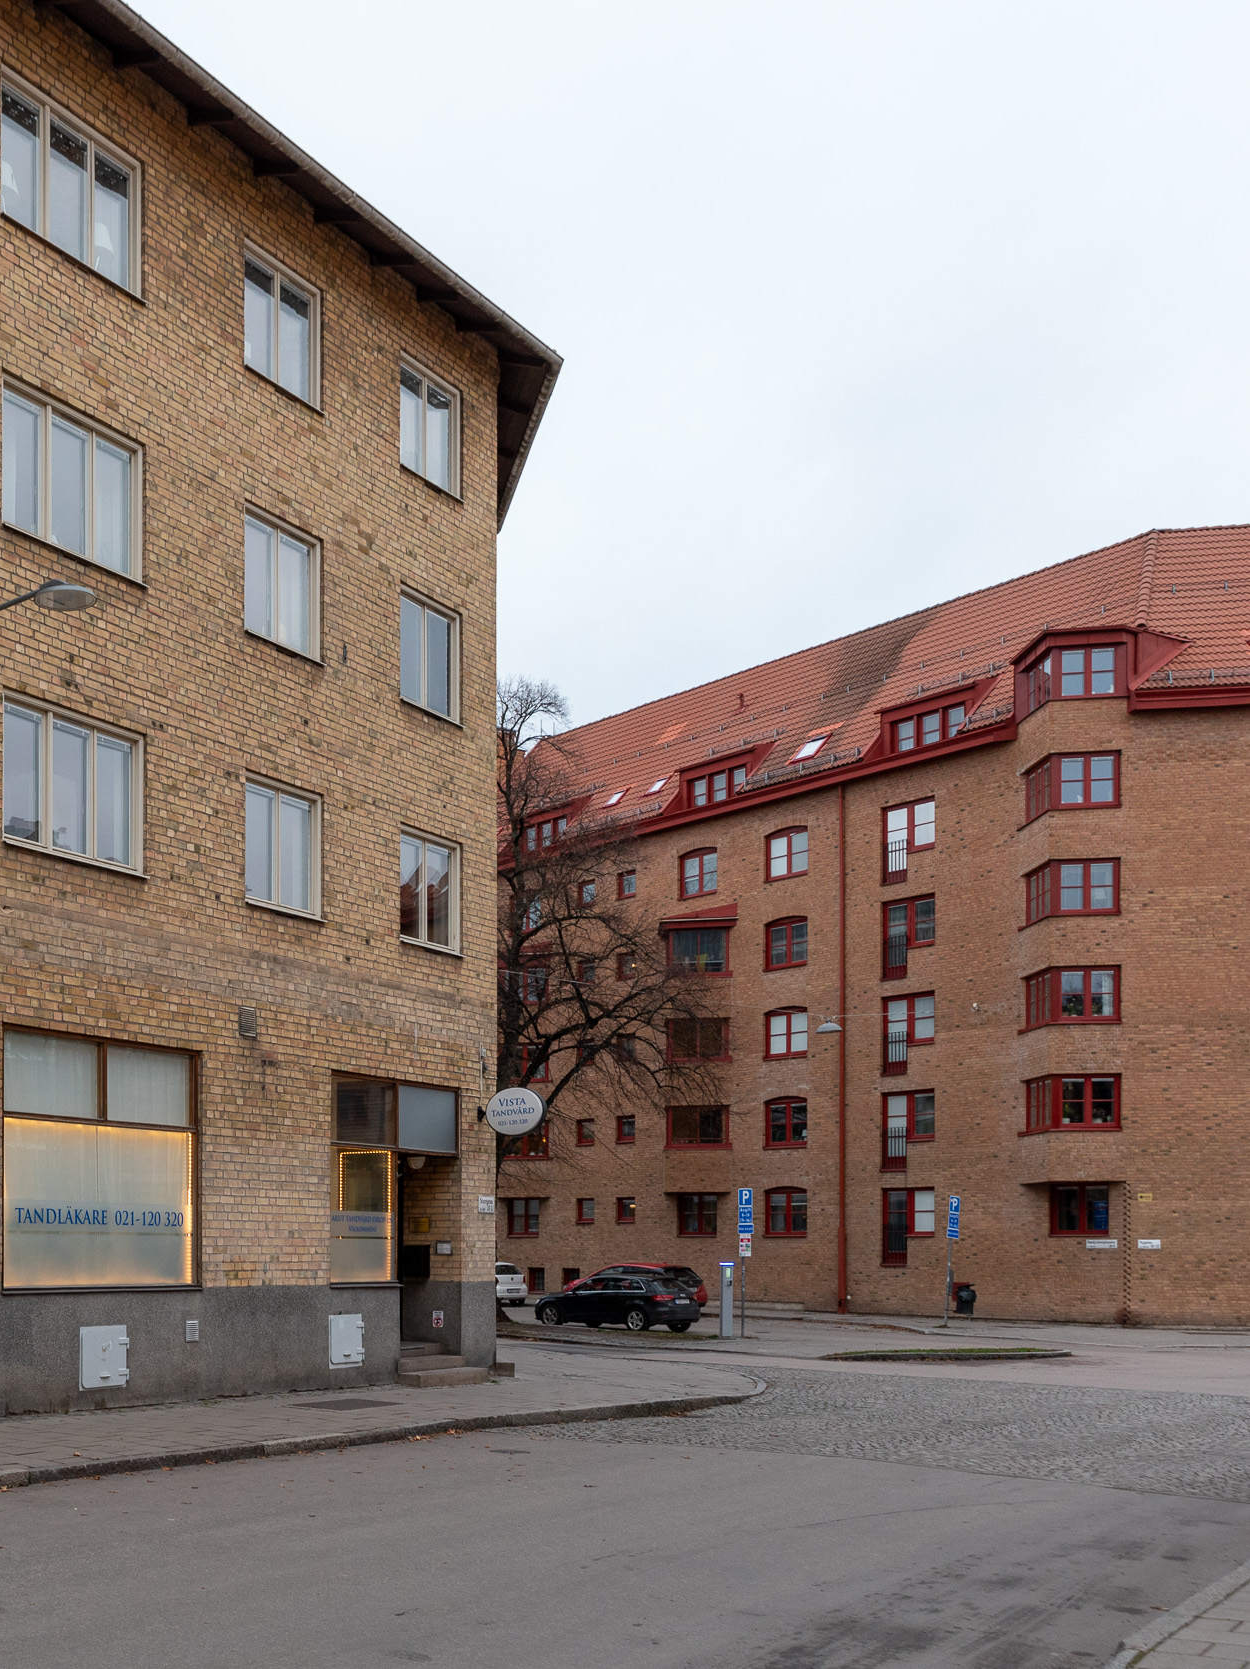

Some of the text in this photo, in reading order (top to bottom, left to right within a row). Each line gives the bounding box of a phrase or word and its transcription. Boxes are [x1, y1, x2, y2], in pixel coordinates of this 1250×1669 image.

[498, 1097, 526, 1107] VISTA
[491, 1106, 535, 1117] TANDVÅRD
[742, 1190, 750, 1204] P
[952, 1198, 958, 1210] P
[14, 1205, 184, 1227] TANDLÄKARE 021-120 320
